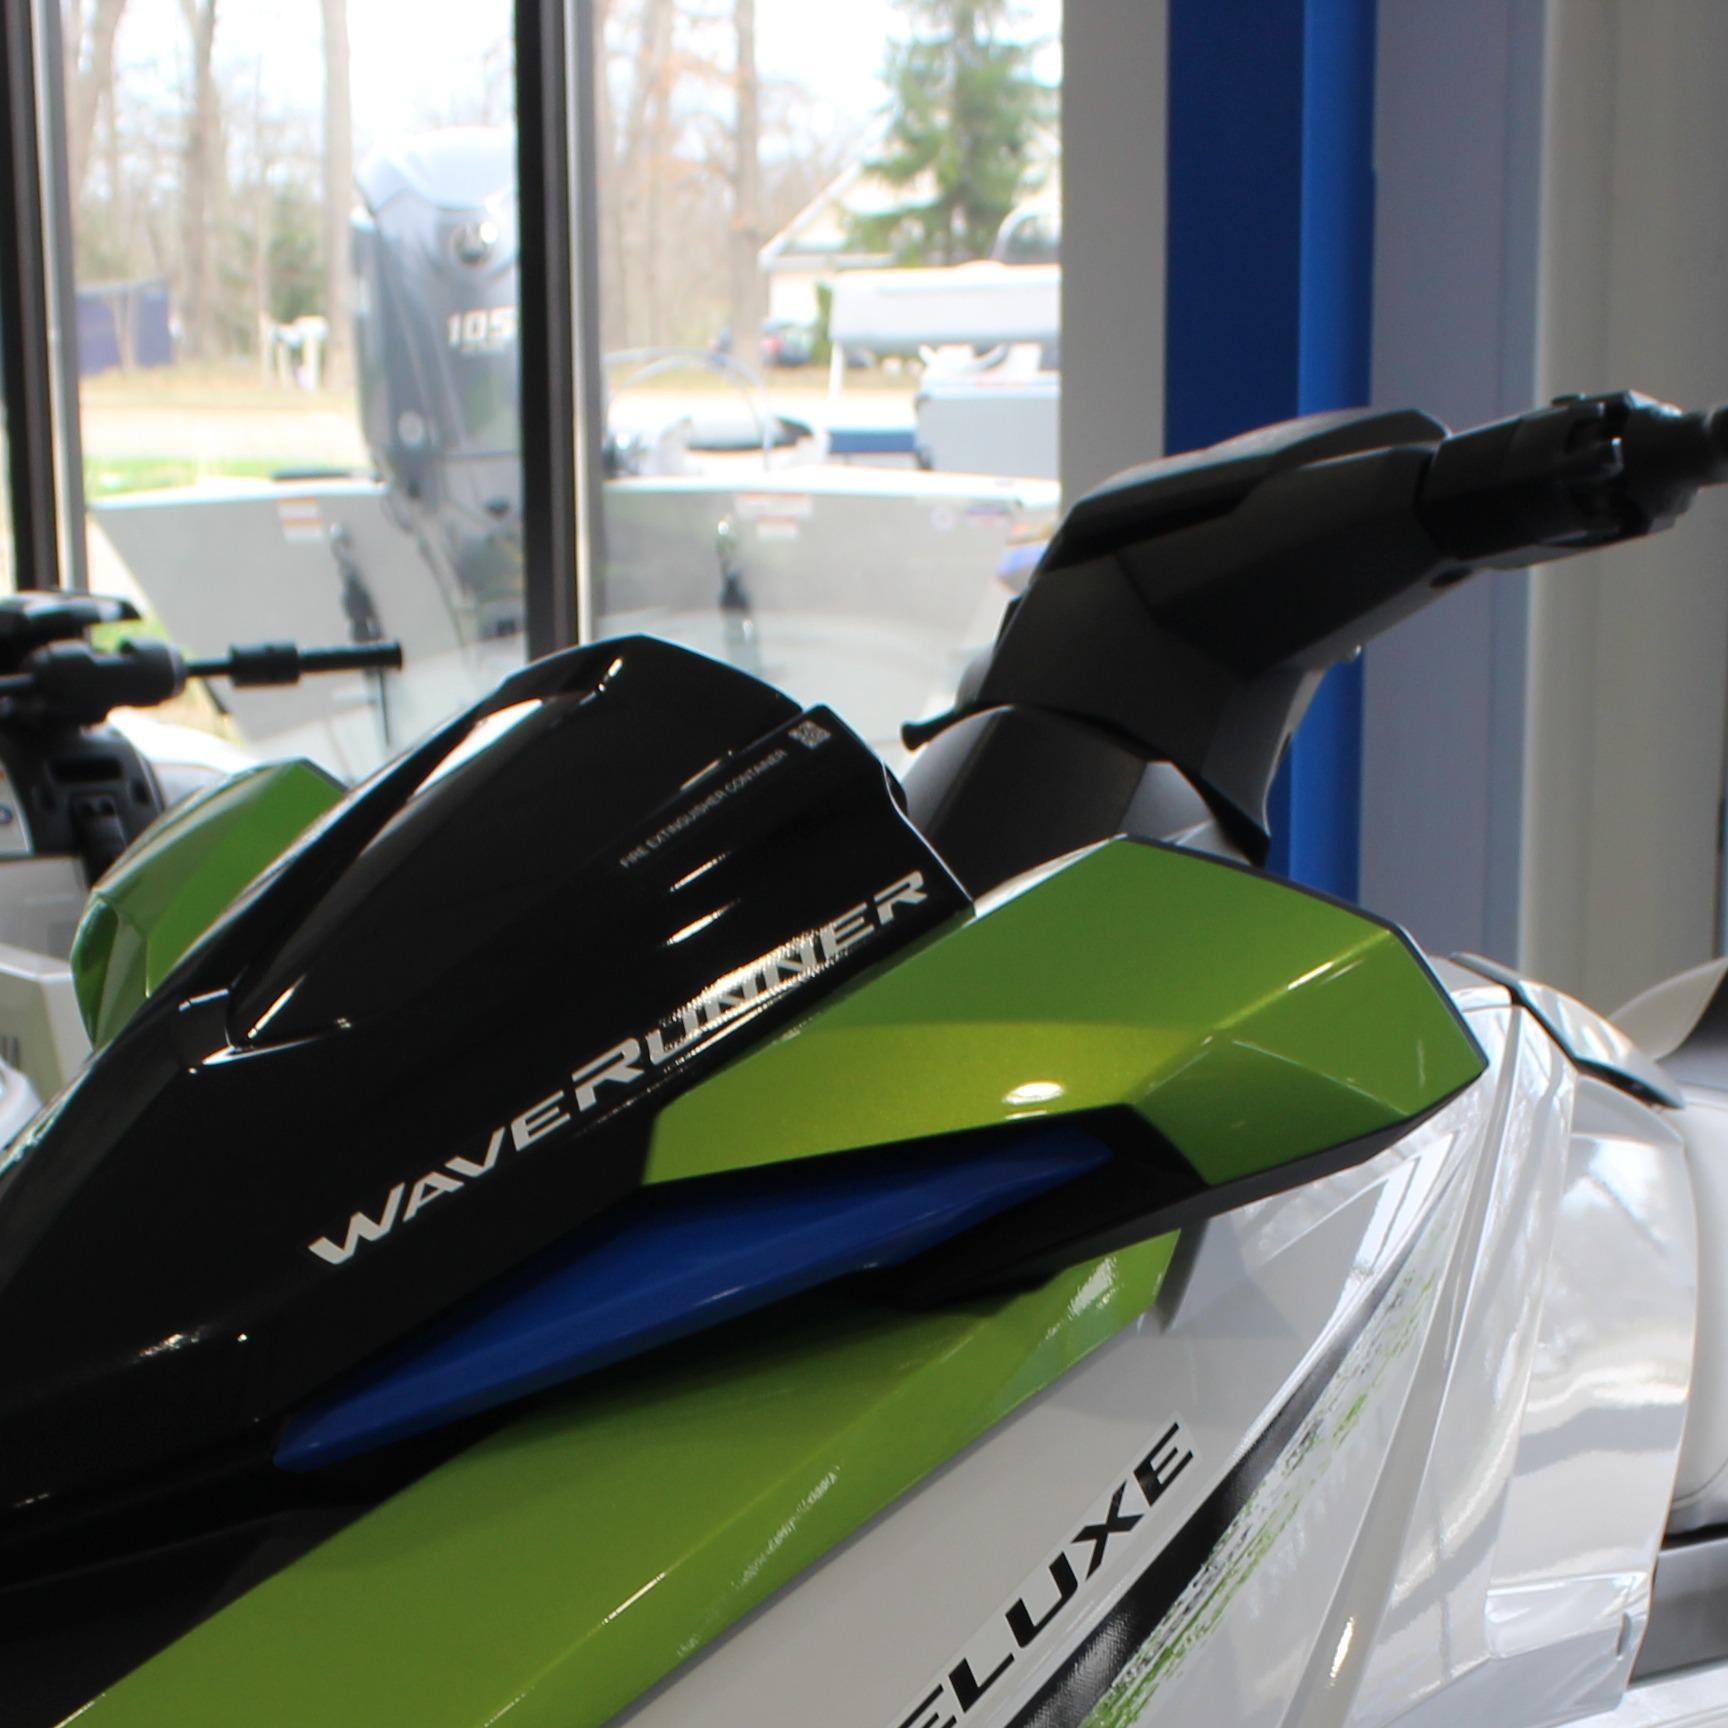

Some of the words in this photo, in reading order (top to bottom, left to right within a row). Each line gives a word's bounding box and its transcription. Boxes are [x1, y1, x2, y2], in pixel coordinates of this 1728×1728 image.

[619, 846, 649, 868] FIRE
[646, 789, 728, 848] EXTINGUISHER
[725, 749, 787, 792] CONTAINER
